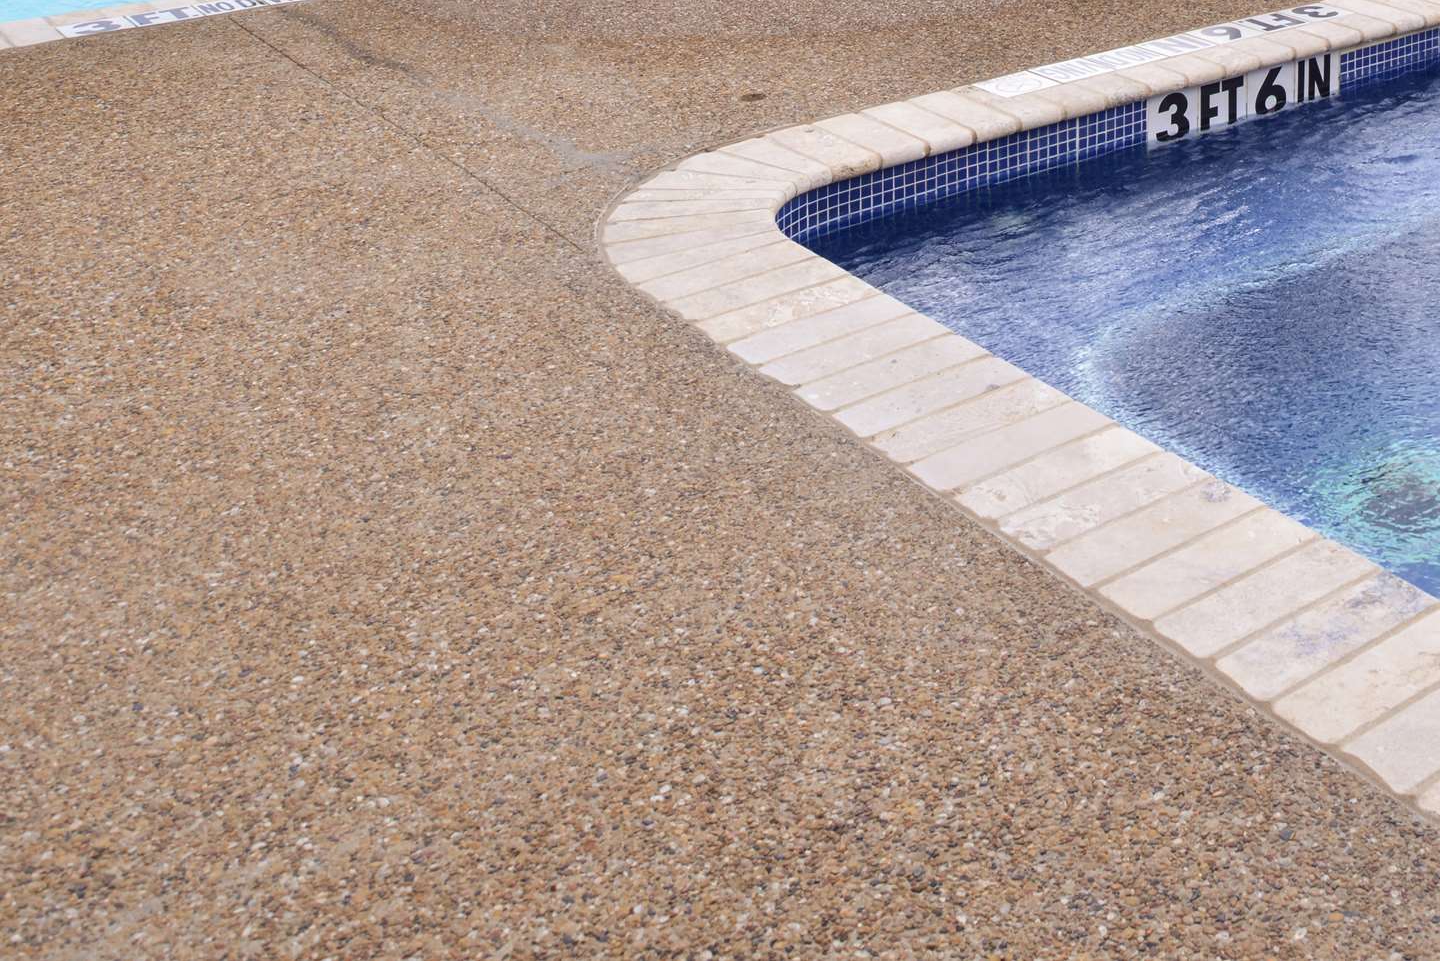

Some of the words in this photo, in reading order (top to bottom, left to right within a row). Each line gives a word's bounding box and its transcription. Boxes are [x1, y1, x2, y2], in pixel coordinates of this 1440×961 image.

[1291, 5, 1339, 19] 3
[72, 20, 121, 35] 3
[1200, 25, 1243, 40] 6
[1155, 92, 1190, 142] 3
[1200, 75, 1245, 131] FT
[1255, 65, 1287, 116] 6
[1296, 53, 1332, 103] IN
